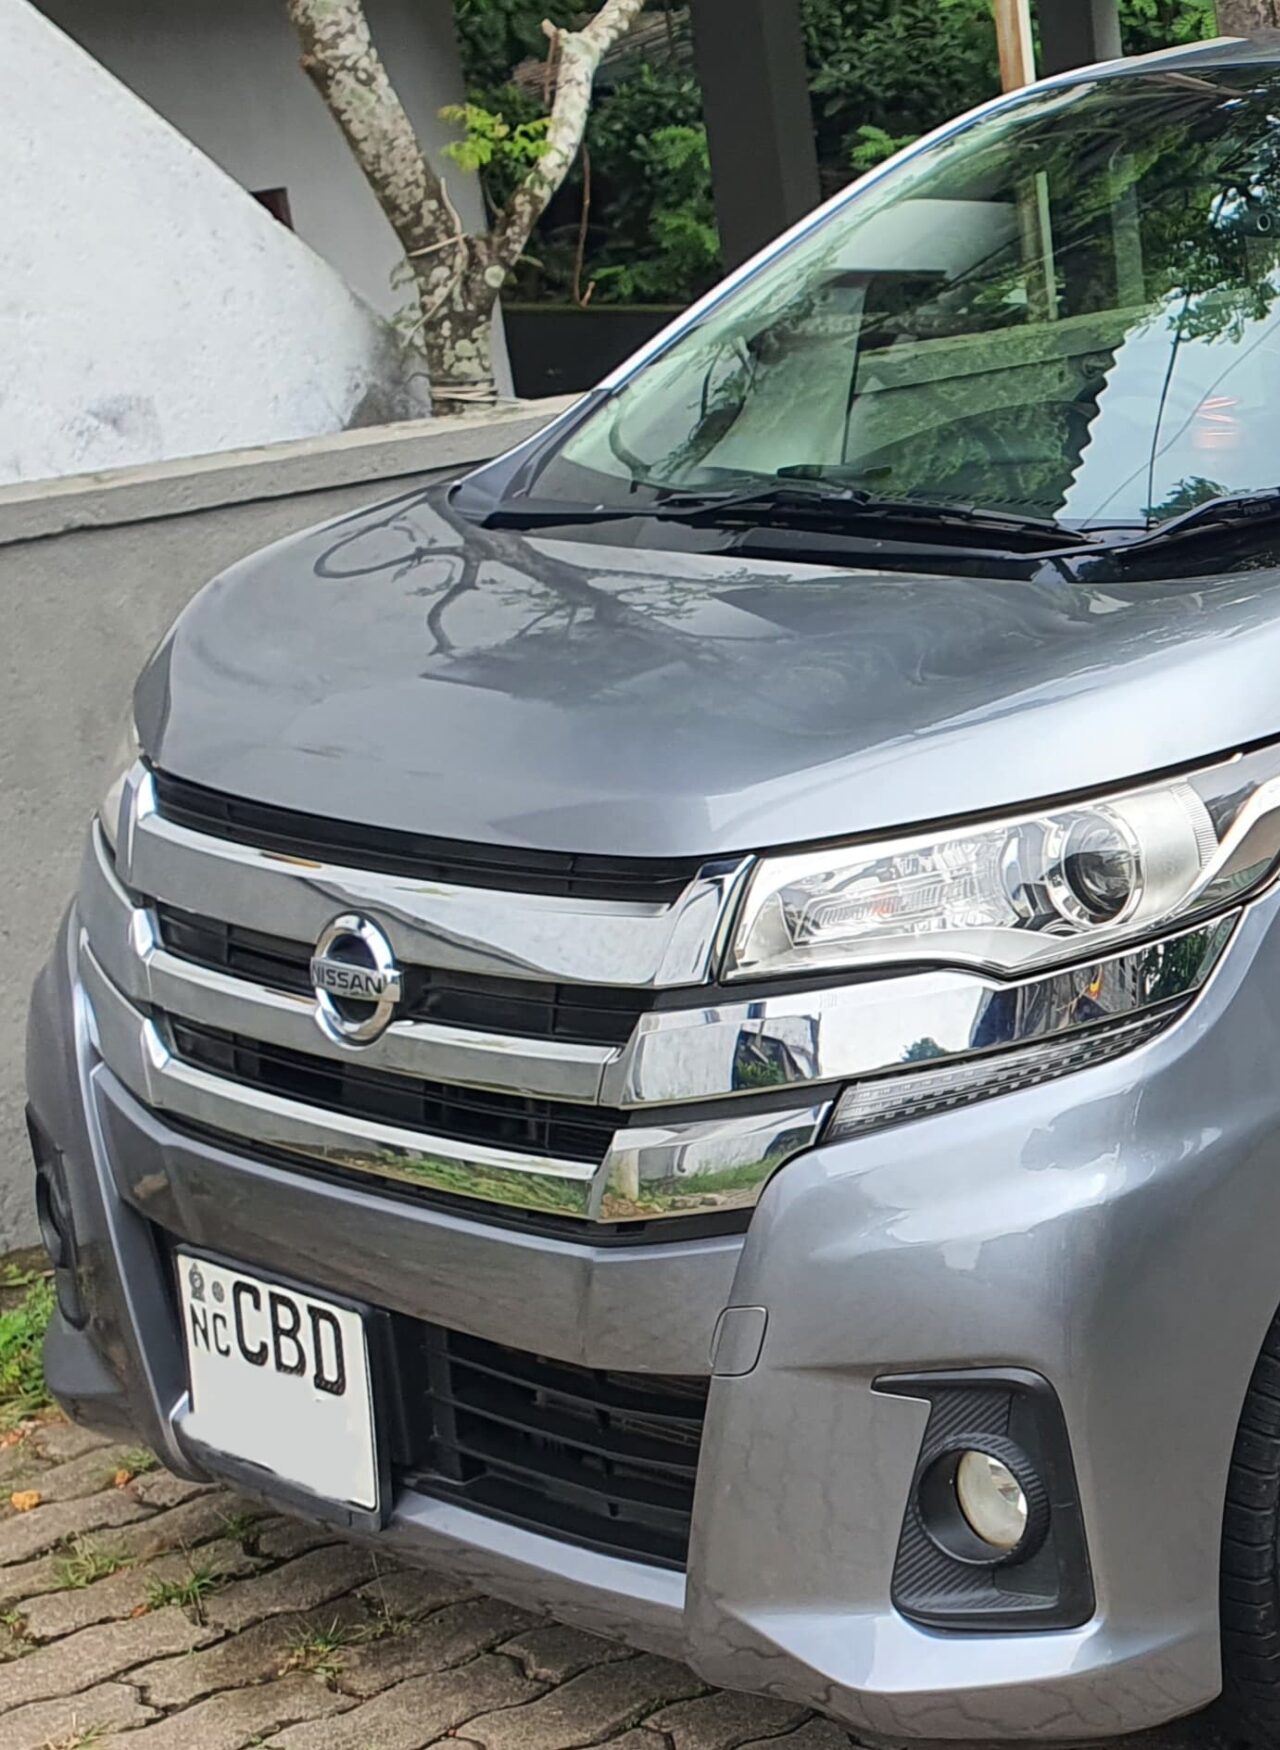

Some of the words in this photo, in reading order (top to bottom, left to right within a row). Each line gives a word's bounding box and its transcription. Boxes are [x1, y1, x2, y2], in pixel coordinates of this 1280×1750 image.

[312, 964, 383, 994] NISSAN
[190, 1303, 231, 1357] NC
[233, 1281, 346, 1396] CBD
